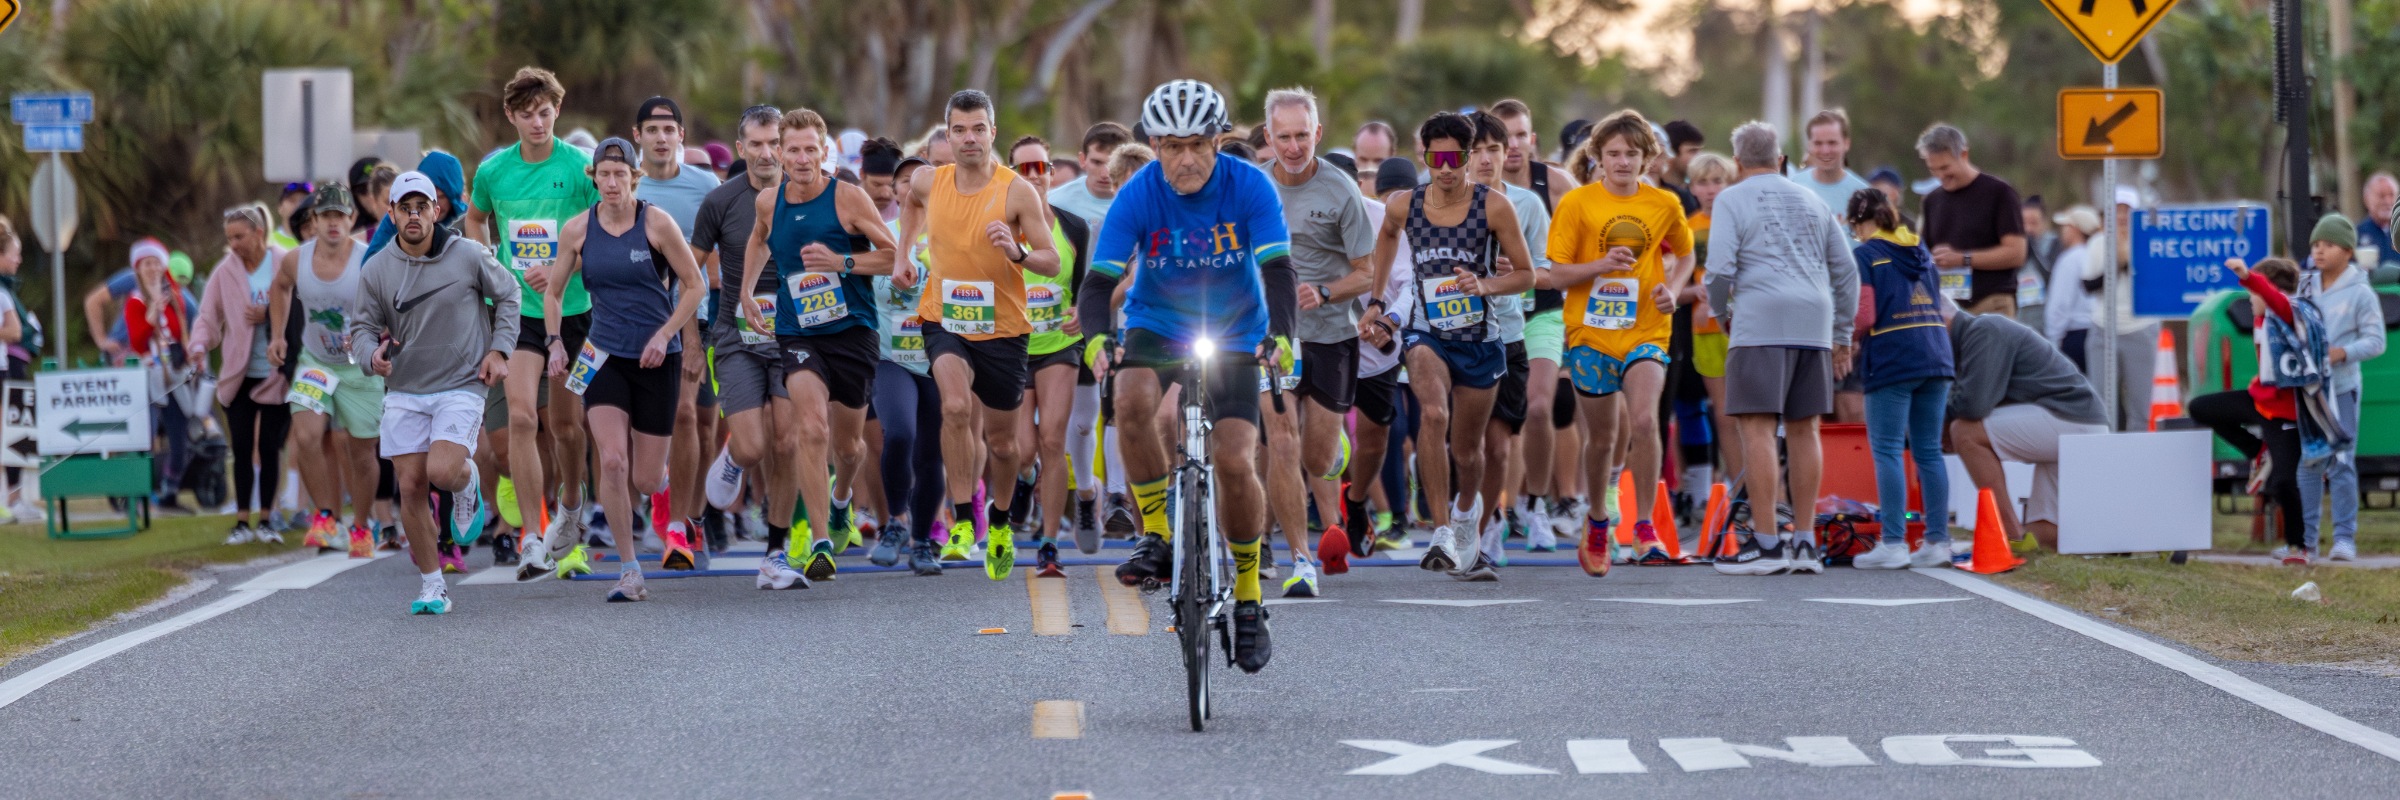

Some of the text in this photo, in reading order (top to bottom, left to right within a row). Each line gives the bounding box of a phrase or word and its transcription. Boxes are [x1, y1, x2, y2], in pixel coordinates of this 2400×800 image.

[1600, 217, 1616, 238] BEFORE
[516, 243, 552, 258] 229
[2150, 237, 2250, 258] RECINTO
[1146, 252, 1245, 269] OF SANCAP
[1416, 248, 1477, 264] MACLAY
[802, 276, 824, 288] FISH
[1604, 286, 1625, 294] FISH
[801, 290, 837, 314] 228
[1438, 298, 1471, 318] 101
[1594, 300, 1628, 316] 213
[804, 314, 820, 324] 5K
[952, 306, 983, 320] 361
[950, 323, 966, 332] 10K
[1438, 320, 1455, 329] 5K
[1590, 318, 1606, 326] 5K
[900, 336, 924, 350] 42
[61, 380, 119, 394] EVENT
[51, 394, 132, 409] PARKING
[1338, 734, 2102, 776] XING
